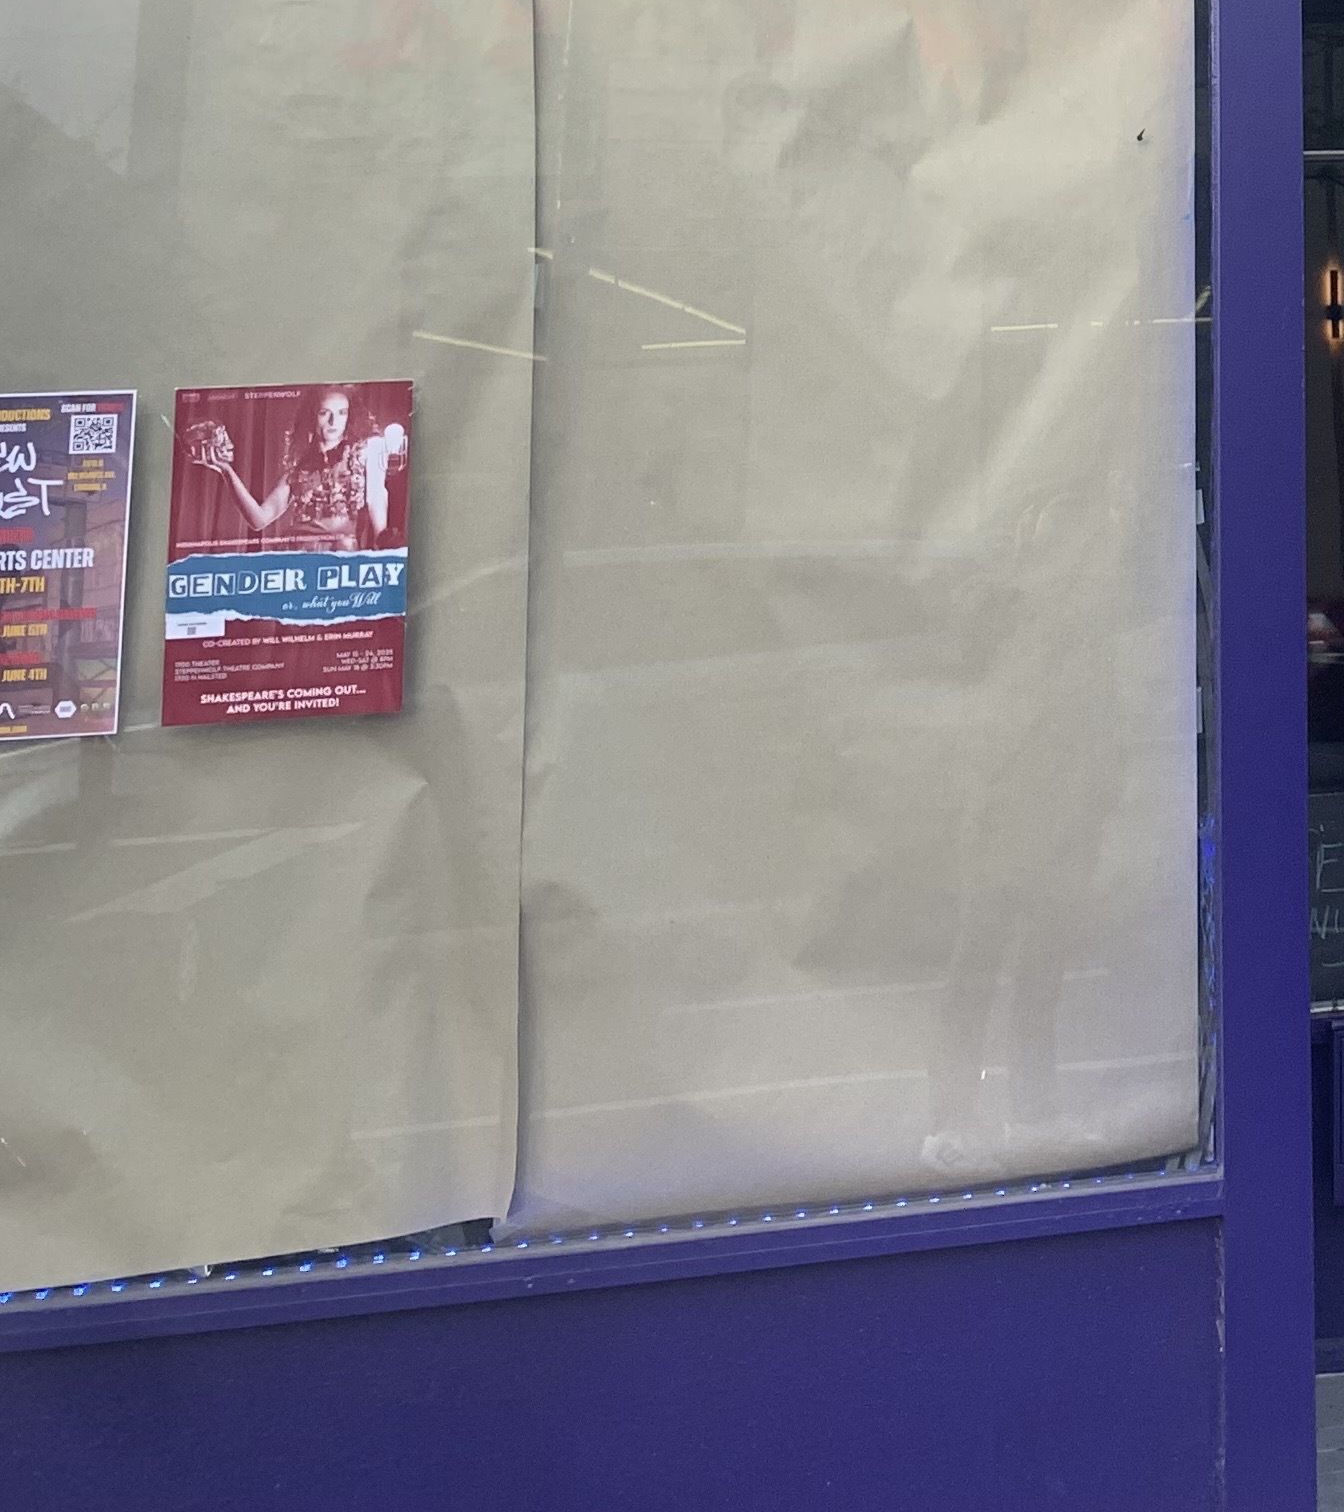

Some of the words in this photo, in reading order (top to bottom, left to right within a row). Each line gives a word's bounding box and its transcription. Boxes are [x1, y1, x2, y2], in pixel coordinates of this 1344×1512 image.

[30, 548, 95, 570] CENTER
[168, 568, 308, 598] GENDER
[316, 562, 404, 591] PLAY
[200, 689, 285, 705] SHAKESPEARE'S
[286, 686, 332, 699] COMING
[226, 703, 251, 714] AND
[252, 700, 292, 713] YOU'RE
[294, 697, 340, 710] INVITED!
